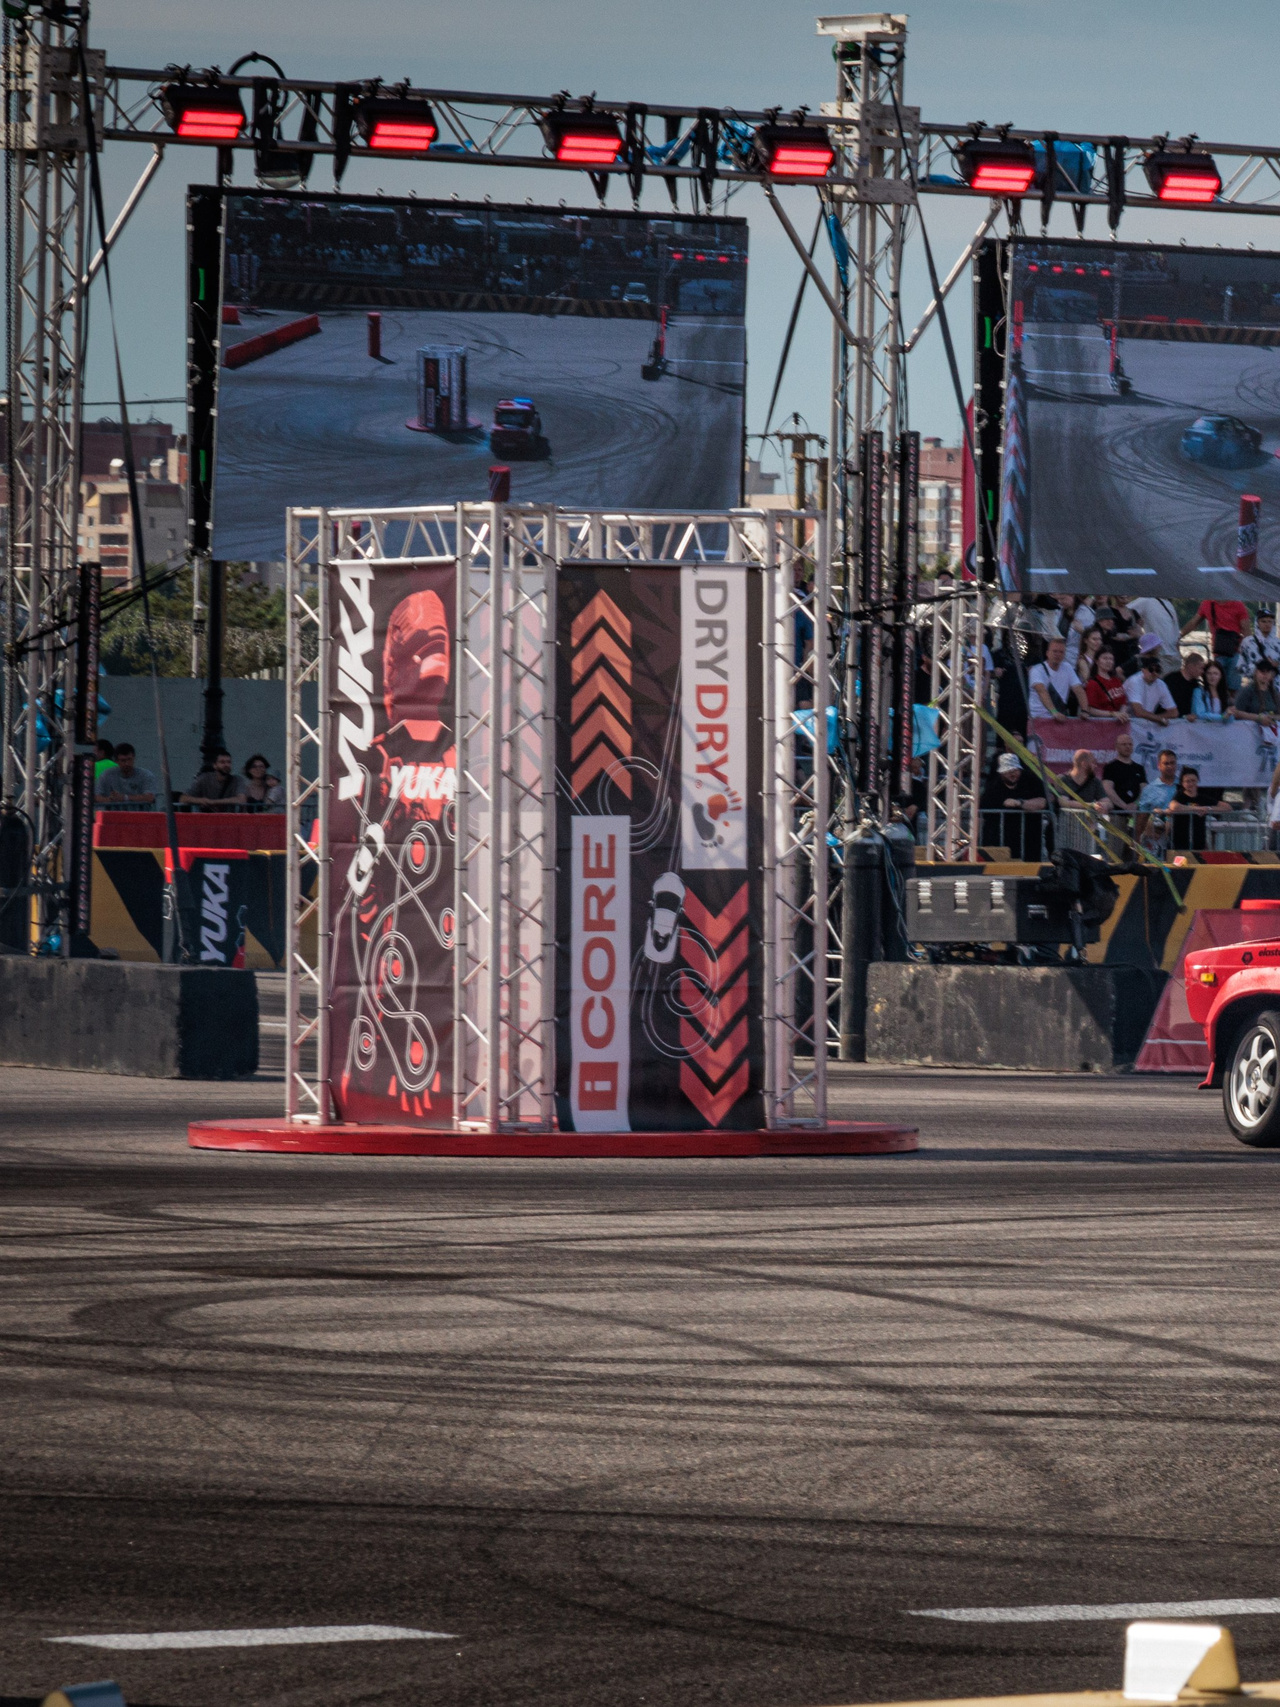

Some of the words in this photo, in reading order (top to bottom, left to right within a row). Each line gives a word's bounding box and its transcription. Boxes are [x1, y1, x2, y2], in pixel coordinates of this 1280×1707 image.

[338, 565, 375, 801] YUKA
[695, 580, 729, 785] DRYDRY
[389, 765, 457, 799] YUKA
[201, 864, 230, 962] YUKA
